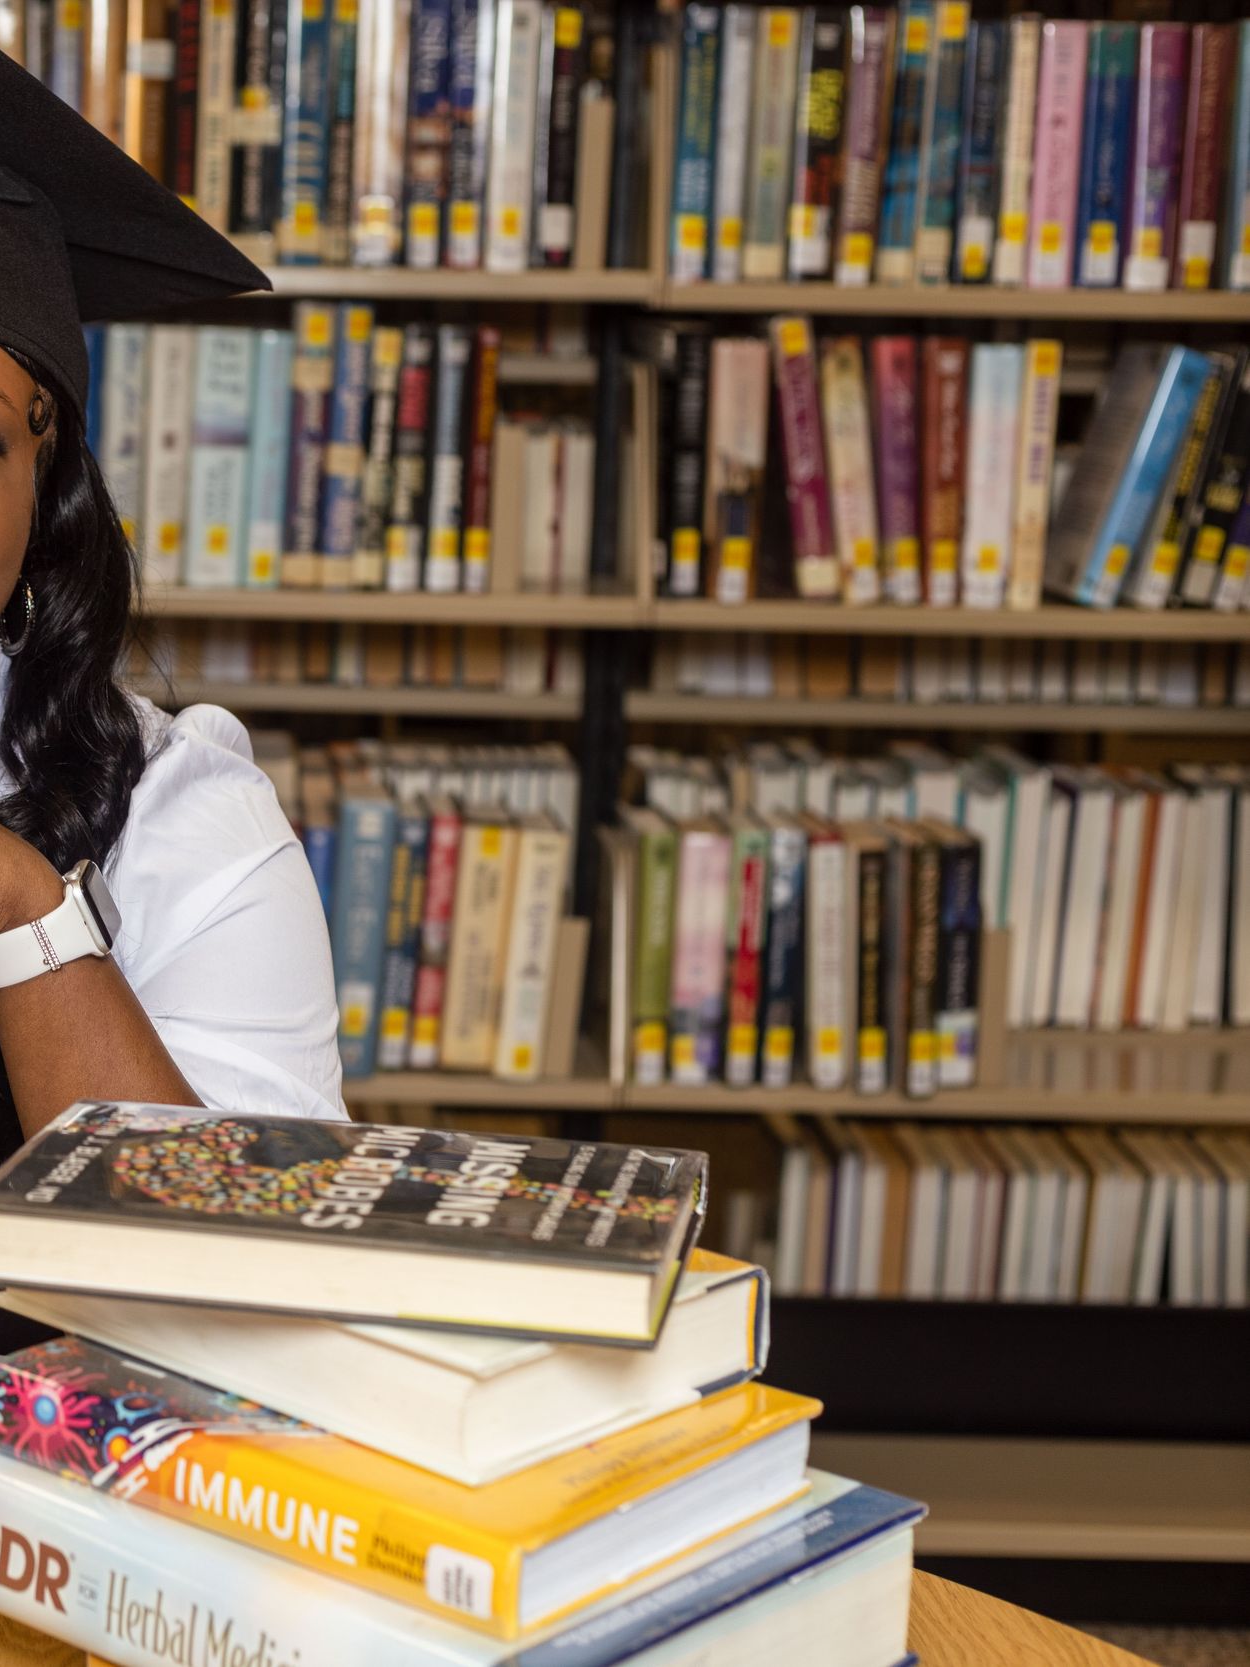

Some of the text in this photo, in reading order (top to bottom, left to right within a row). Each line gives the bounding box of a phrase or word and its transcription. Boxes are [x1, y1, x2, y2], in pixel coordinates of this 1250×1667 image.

[300, 1124, 426, 1231] MICROBES
[425, 1140, 531, 1229] MISSING
[174, 1456, 361, 1567] IMMUNE
[105, 1569, 198, 1667] Herbal
